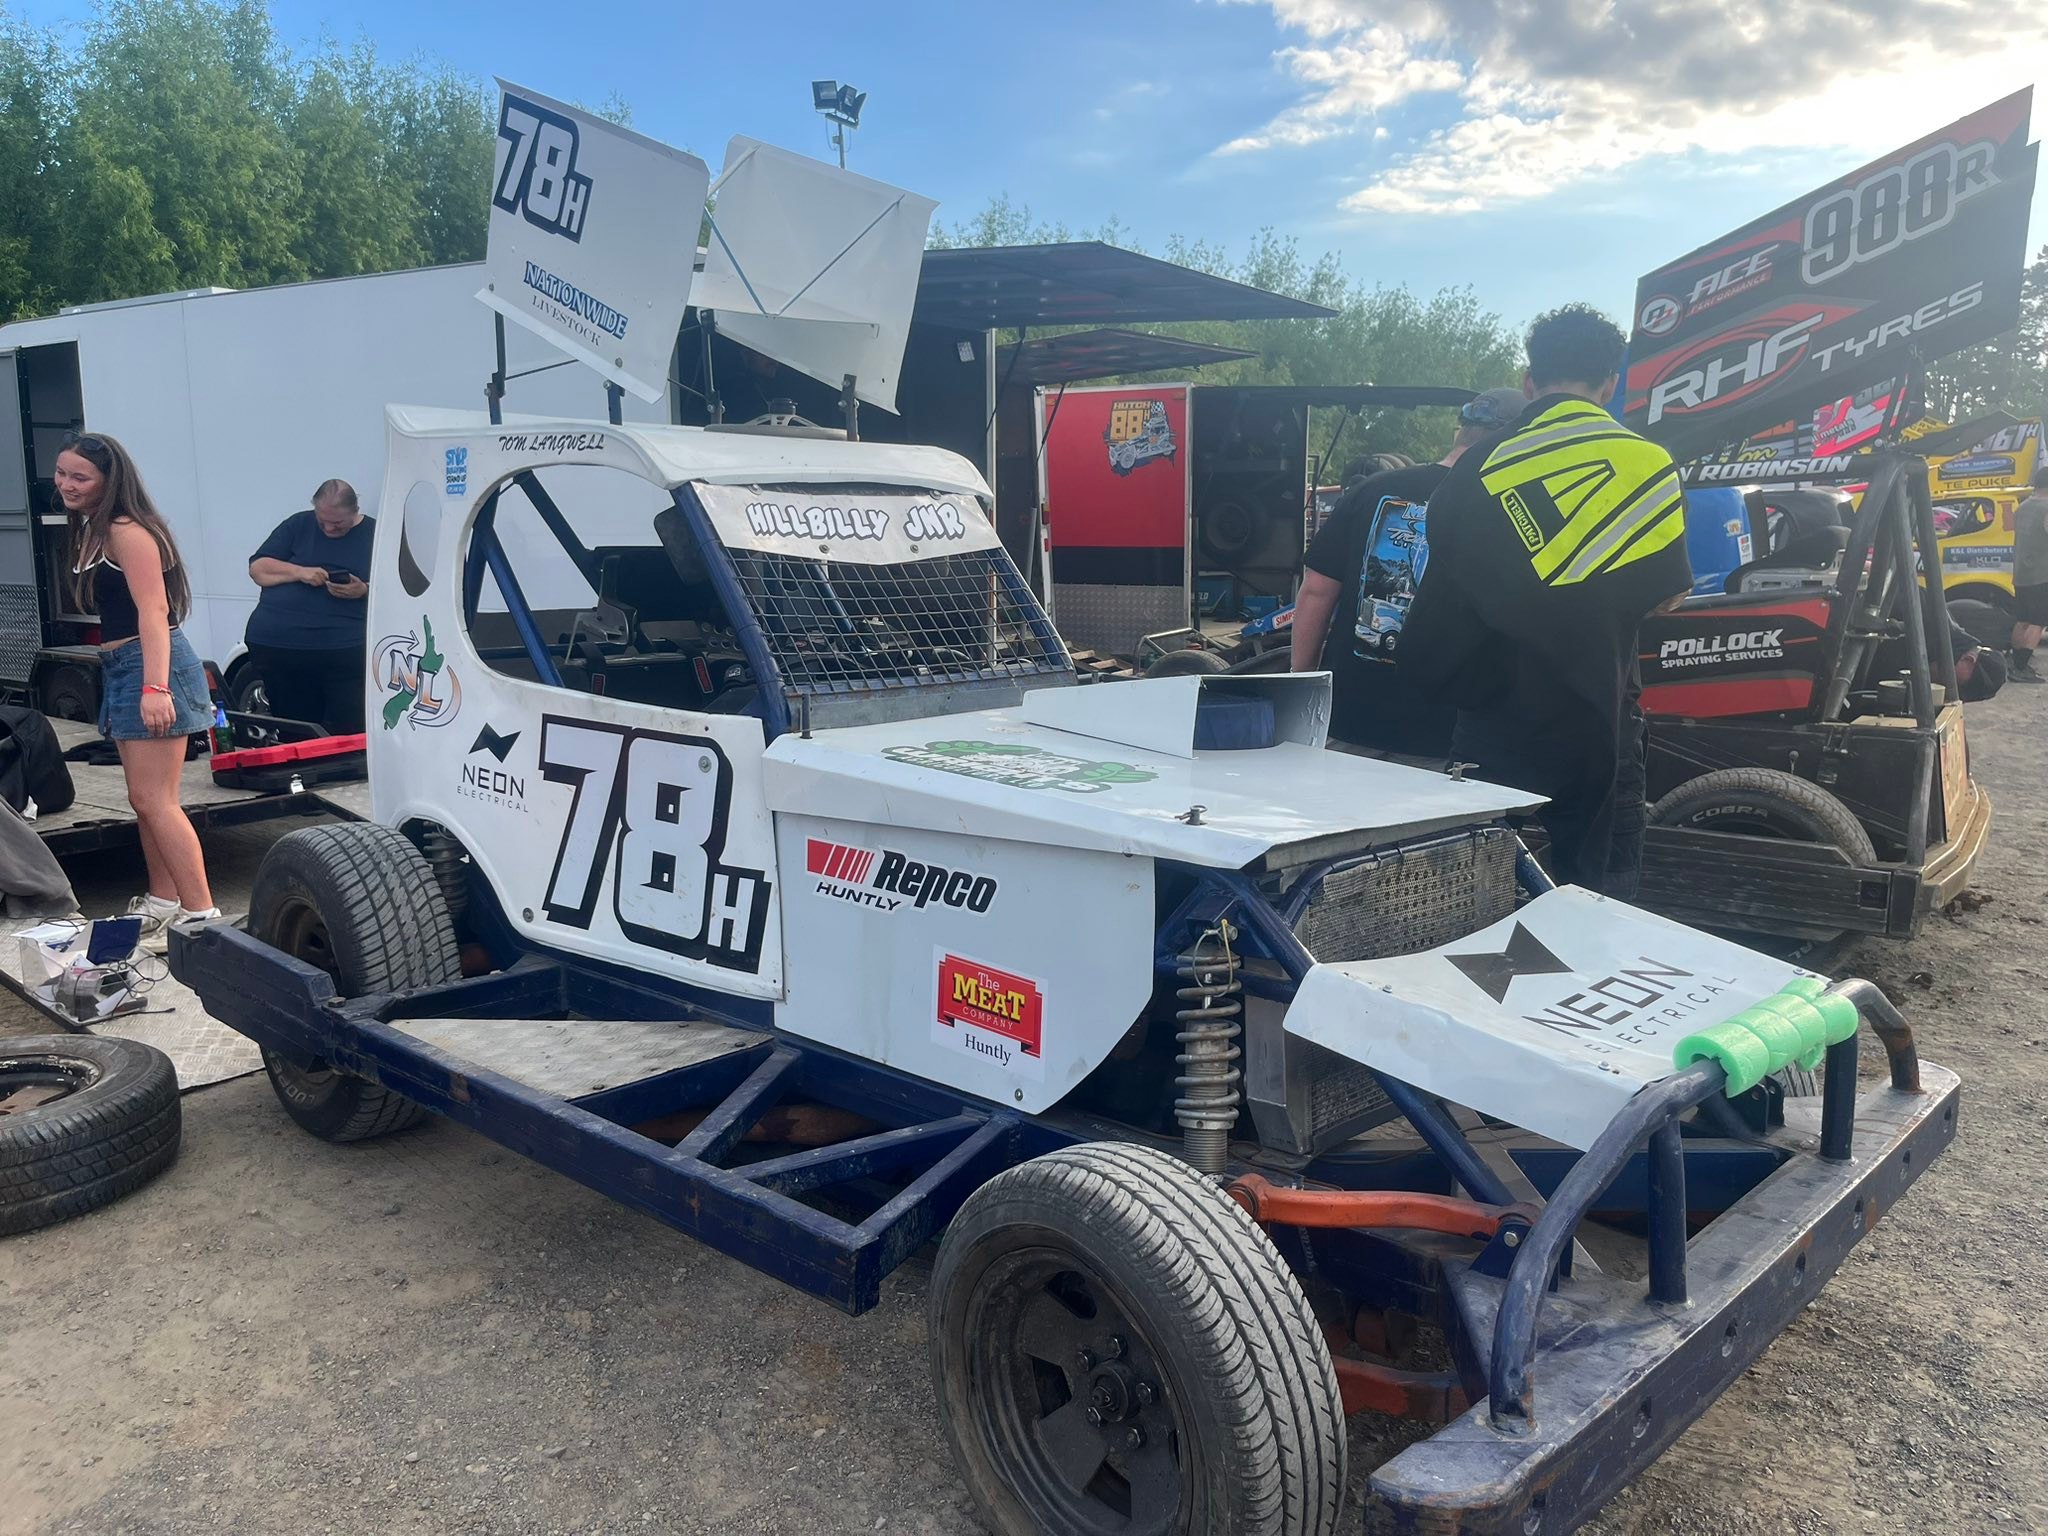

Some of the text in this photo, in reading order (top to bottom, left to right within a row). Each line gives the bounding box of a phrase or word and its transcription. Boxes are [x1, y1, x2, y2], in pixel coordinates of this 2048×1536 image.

[492, 92, 594, 244] 78H
[1802, 139, 2002, 286] 988R
[1685, 243, 1780, 305] ACE
[524, 261, 629, 341] NATIONWIDE
[531, 295, 601, 347] LIVESTOCK
[1812, 281, 1984, 372] TYRES
[1647, 313, 1824, 426] RHF
[1113, 401, 1151, 410] HUTCH
[498, 433, 605, 453] TOM LANGWELL
[1698, 455, 1853, 481] ROBINSON
[1944, 477, 2011, 489] TE PUKE
[745, 502, 966, 541] HILLBILLY JNR
[1506, 492, 1540, 546] PATCHELL
[1660, 629, 1785, 659] POLLOCK
[1661, 648, 1784, 669] SPRAYING SERVICES
[456, 785, 529, 813] ELECTRICAL
[462, 762, 524, 800] NEON
[1692, 804, 1769, 823] COBRA
[538, 713, 772, 974] 78H
[815, 880, 902, 912] HUNTLY
[872, 849, 998, 914] Repco
[951, 972, 1027, 1024] MEAT
[977, 971, 1000, 992] The
[1522, 956, 1694, 1038] NEON
[962, 1006, 1014, 1031] COMPANY
[1585, 975, 1737, 1055] ELECTRICAL
[964, 1032, 1012, 1067] Huntly
